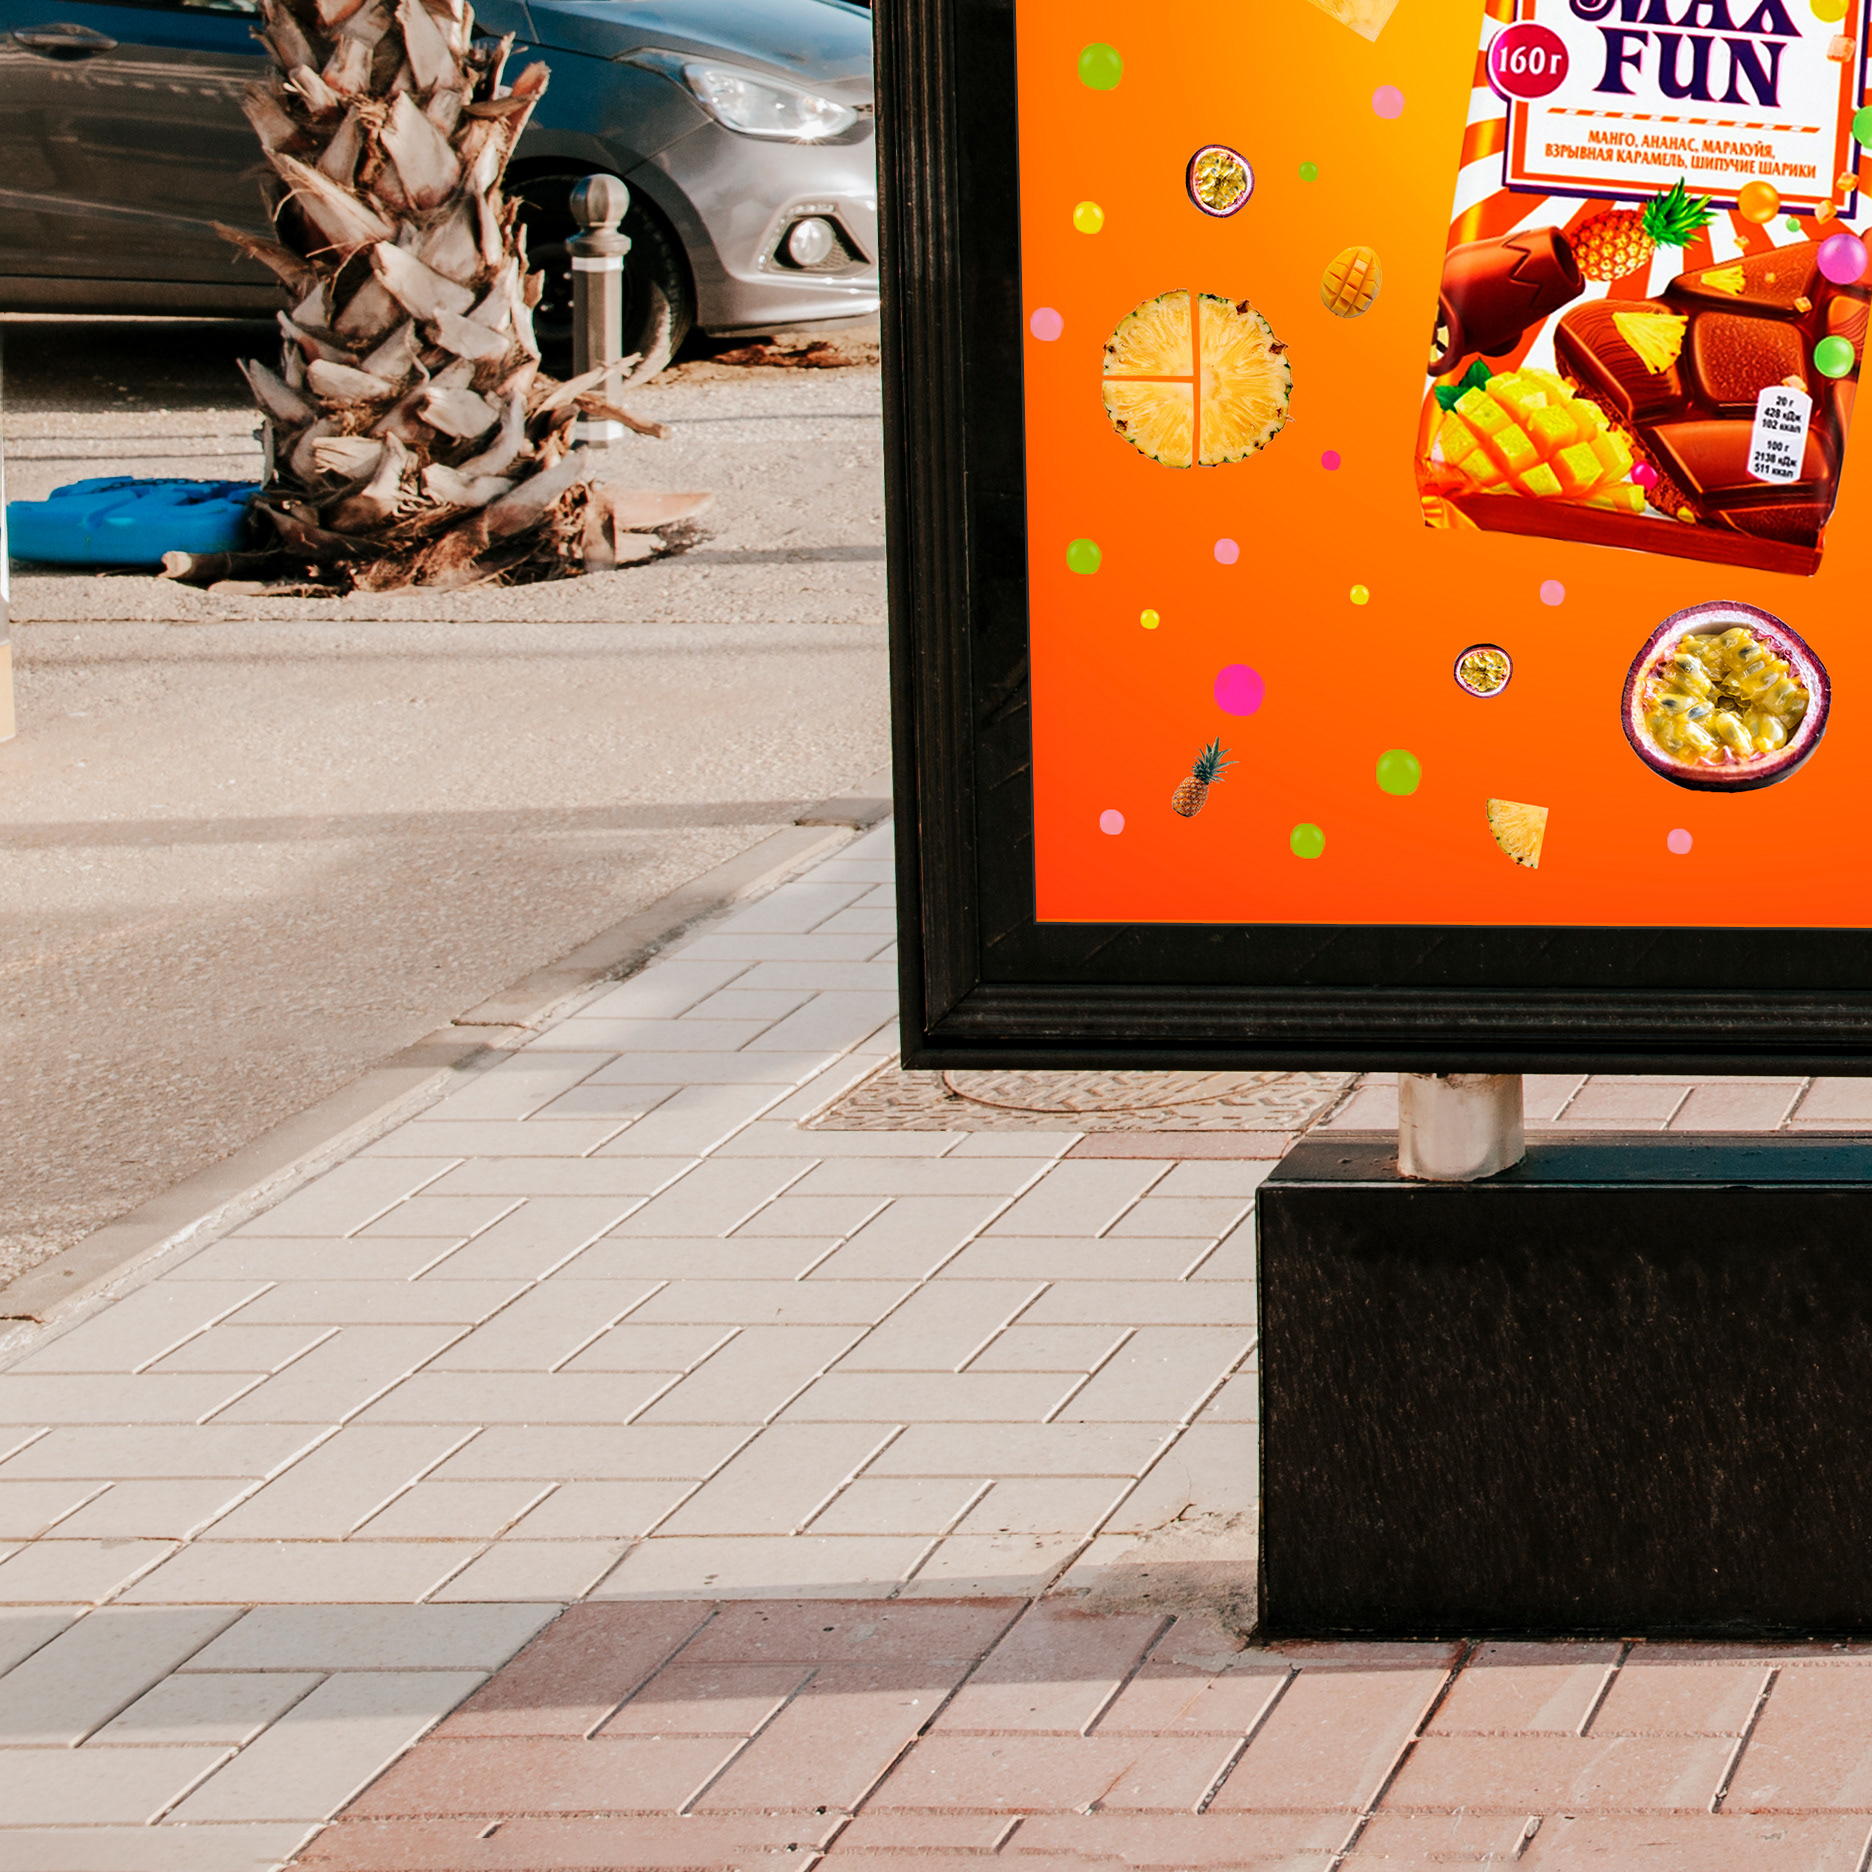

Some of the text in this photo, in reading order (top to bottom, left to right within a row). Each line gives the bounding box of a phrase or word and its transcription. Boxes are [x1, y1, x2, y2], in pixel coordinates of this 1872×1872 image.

[1591, 25, 1788, 108] FUN
[1588, 129, 1776, 159] МАНГО, АНАНАС, МАРАКУЙЯ,
[1544, 143, 1817, 179] ВЗРЫВНАЯ КАРАМЕЛЬ, ШИПУЧИЕ ШАРИКИ
[1762, 418, 1778, 430] 102
[1767, 439, 1783, 452] 100
[1754, 463, 1770, 474] 511
